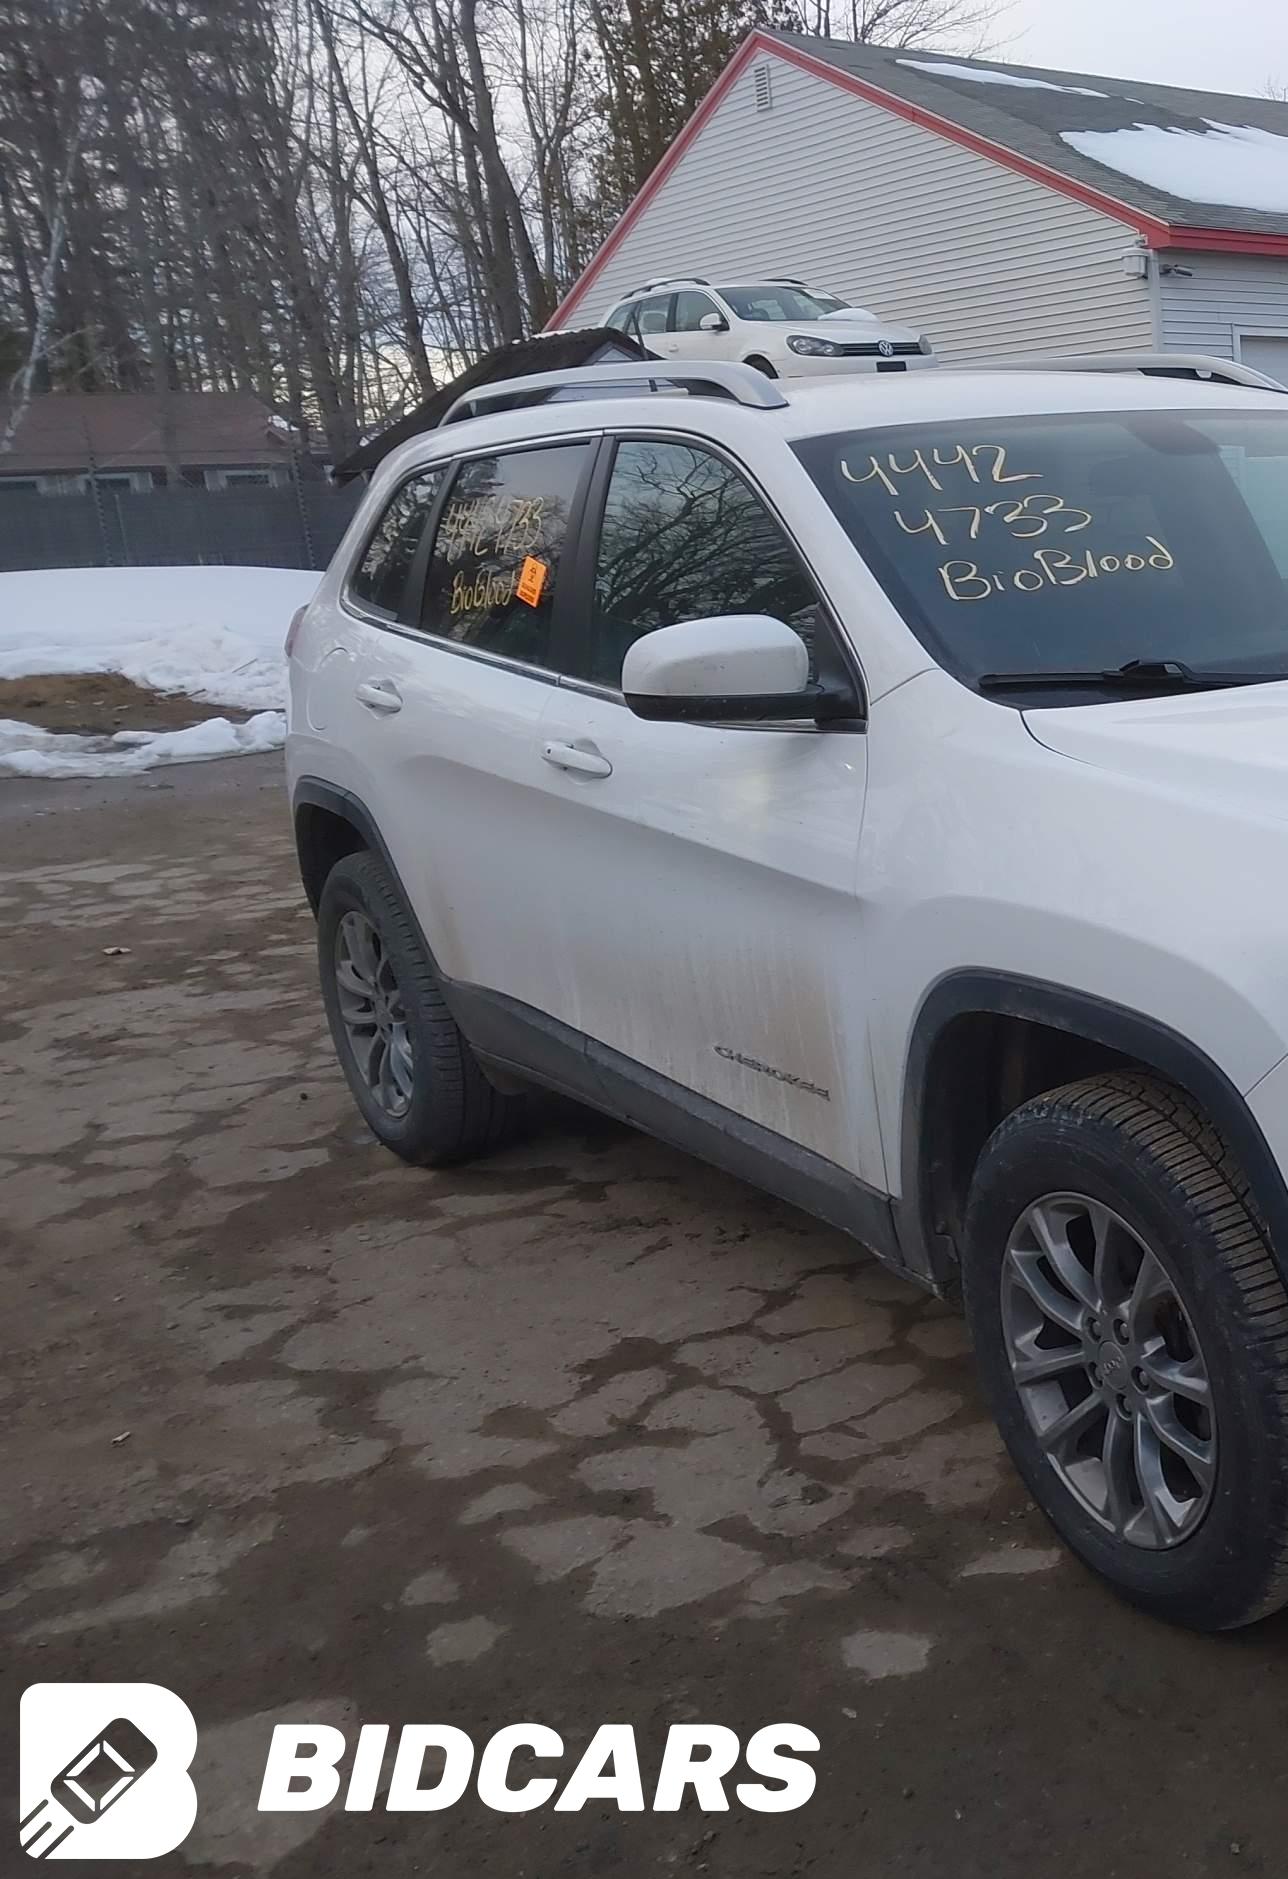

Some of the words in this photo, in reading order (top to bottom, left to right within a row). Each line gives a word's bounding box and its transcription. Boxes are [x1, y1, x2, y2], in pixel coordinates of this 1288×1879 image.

[841, 444, 1044, 496] 4442
[894, 494, 1092, 546] 4733
[938, 536, 1175, 601] BioBlood
